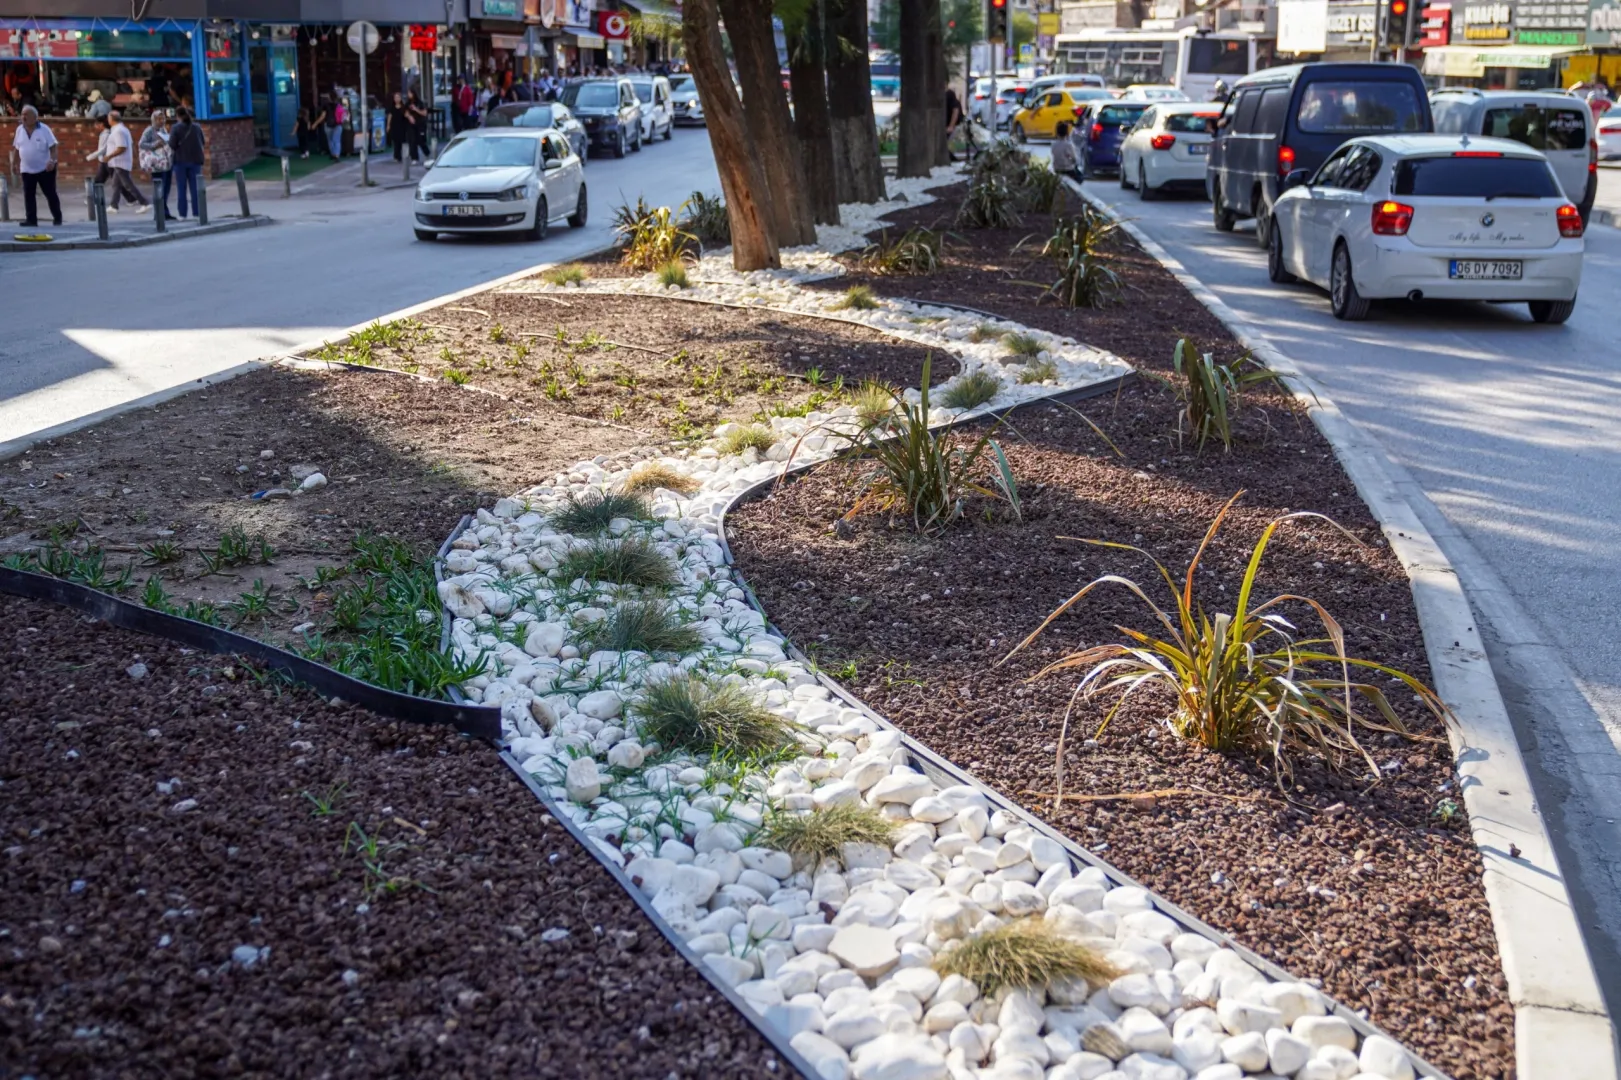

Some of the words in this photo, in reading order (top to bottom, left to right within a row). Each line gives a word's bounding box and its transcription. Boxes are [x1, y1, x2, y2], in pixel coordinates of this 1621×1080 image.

[1449, 231, 1467, 243] My
[1468, 232, 1481, 244] life
[1489, 231, 1507, 244] My
[1456, 262, 1471, 274] 06
[1474, 262, 1488, 274] DY
[1491, 262, 1520, 275] 7092
